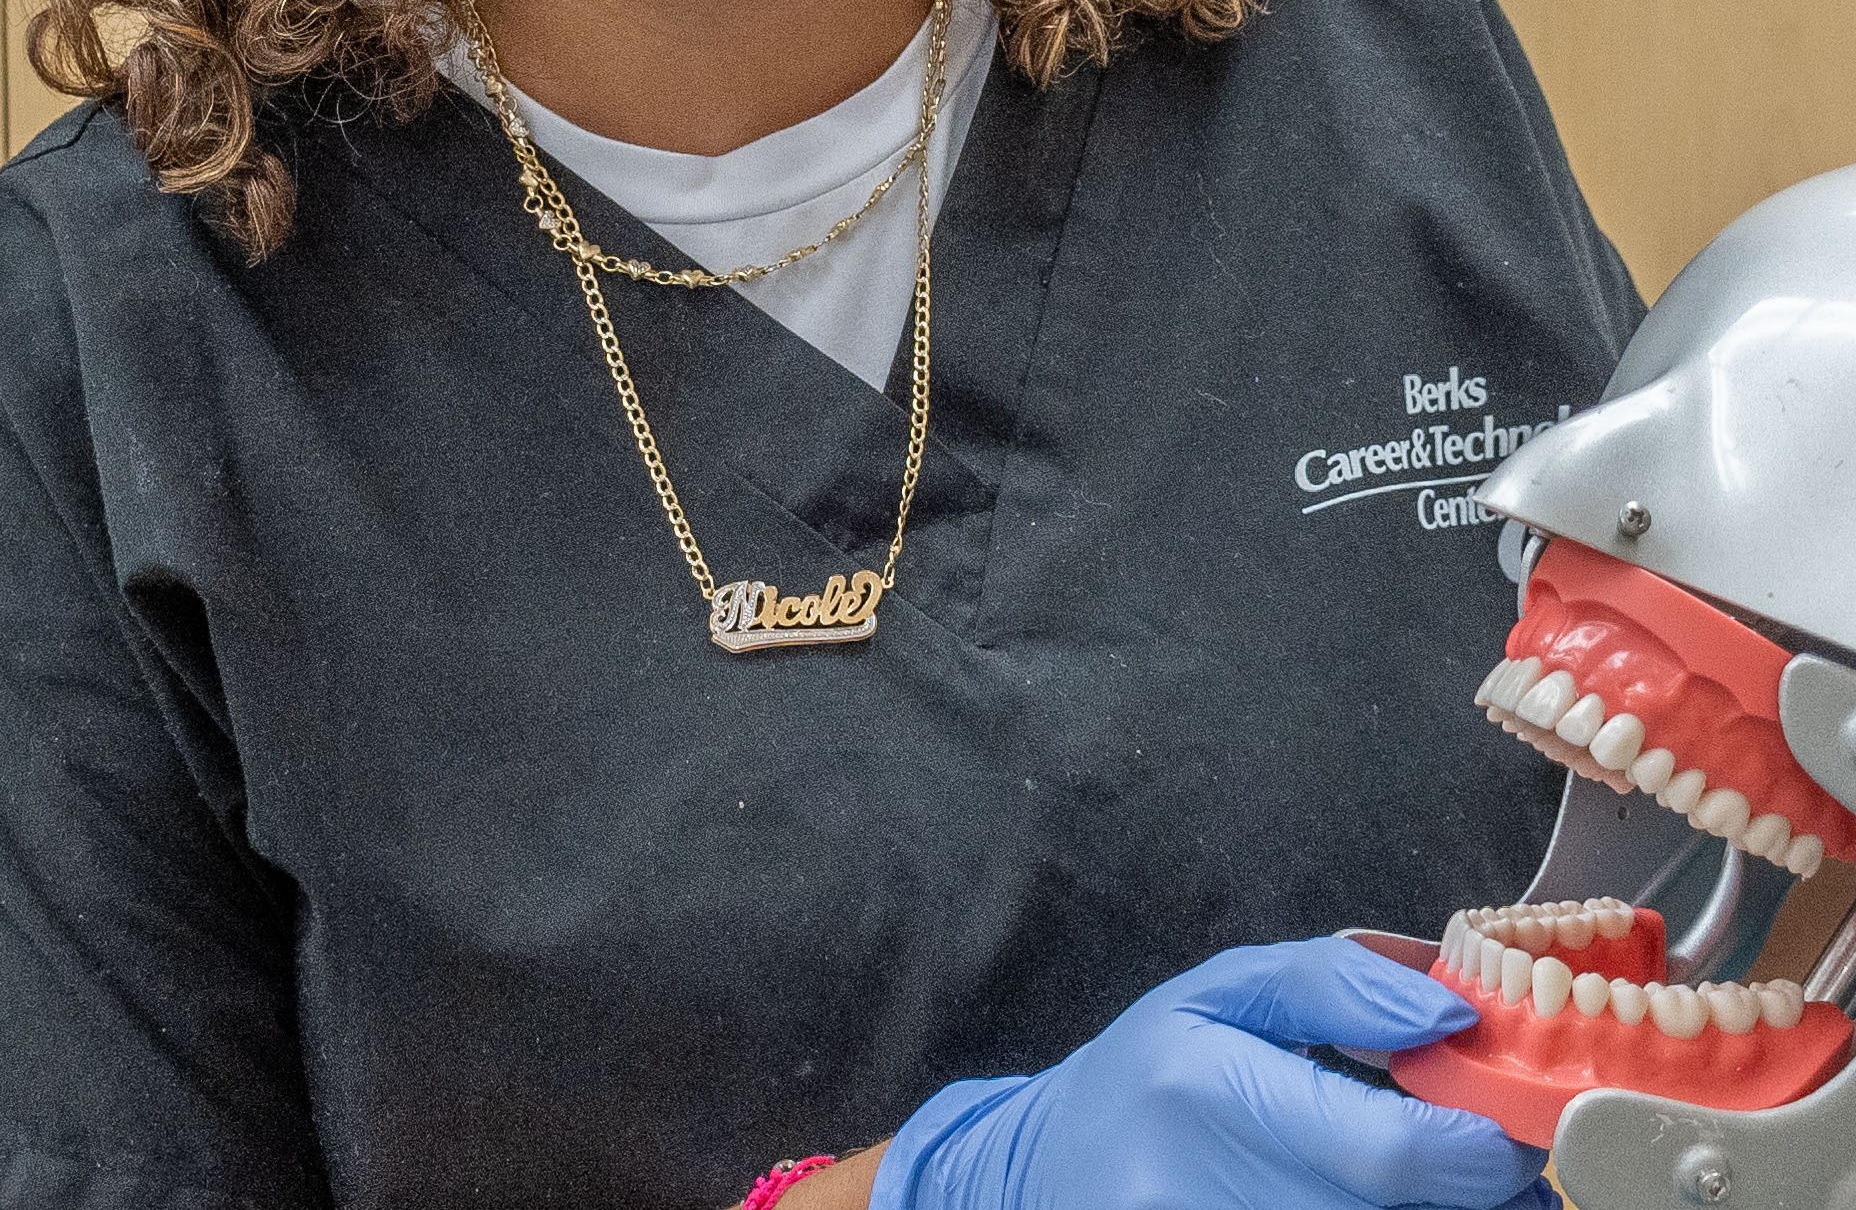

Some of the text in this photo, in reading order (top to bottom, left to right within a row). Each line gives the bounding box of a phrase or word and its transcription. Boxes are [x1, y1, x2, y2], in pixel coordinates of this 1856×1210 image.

[1403, 366, 1487, 415] Berks
[1416, 487, 1505, 530] Cente
[709, 569, 883, 634] Nicole
